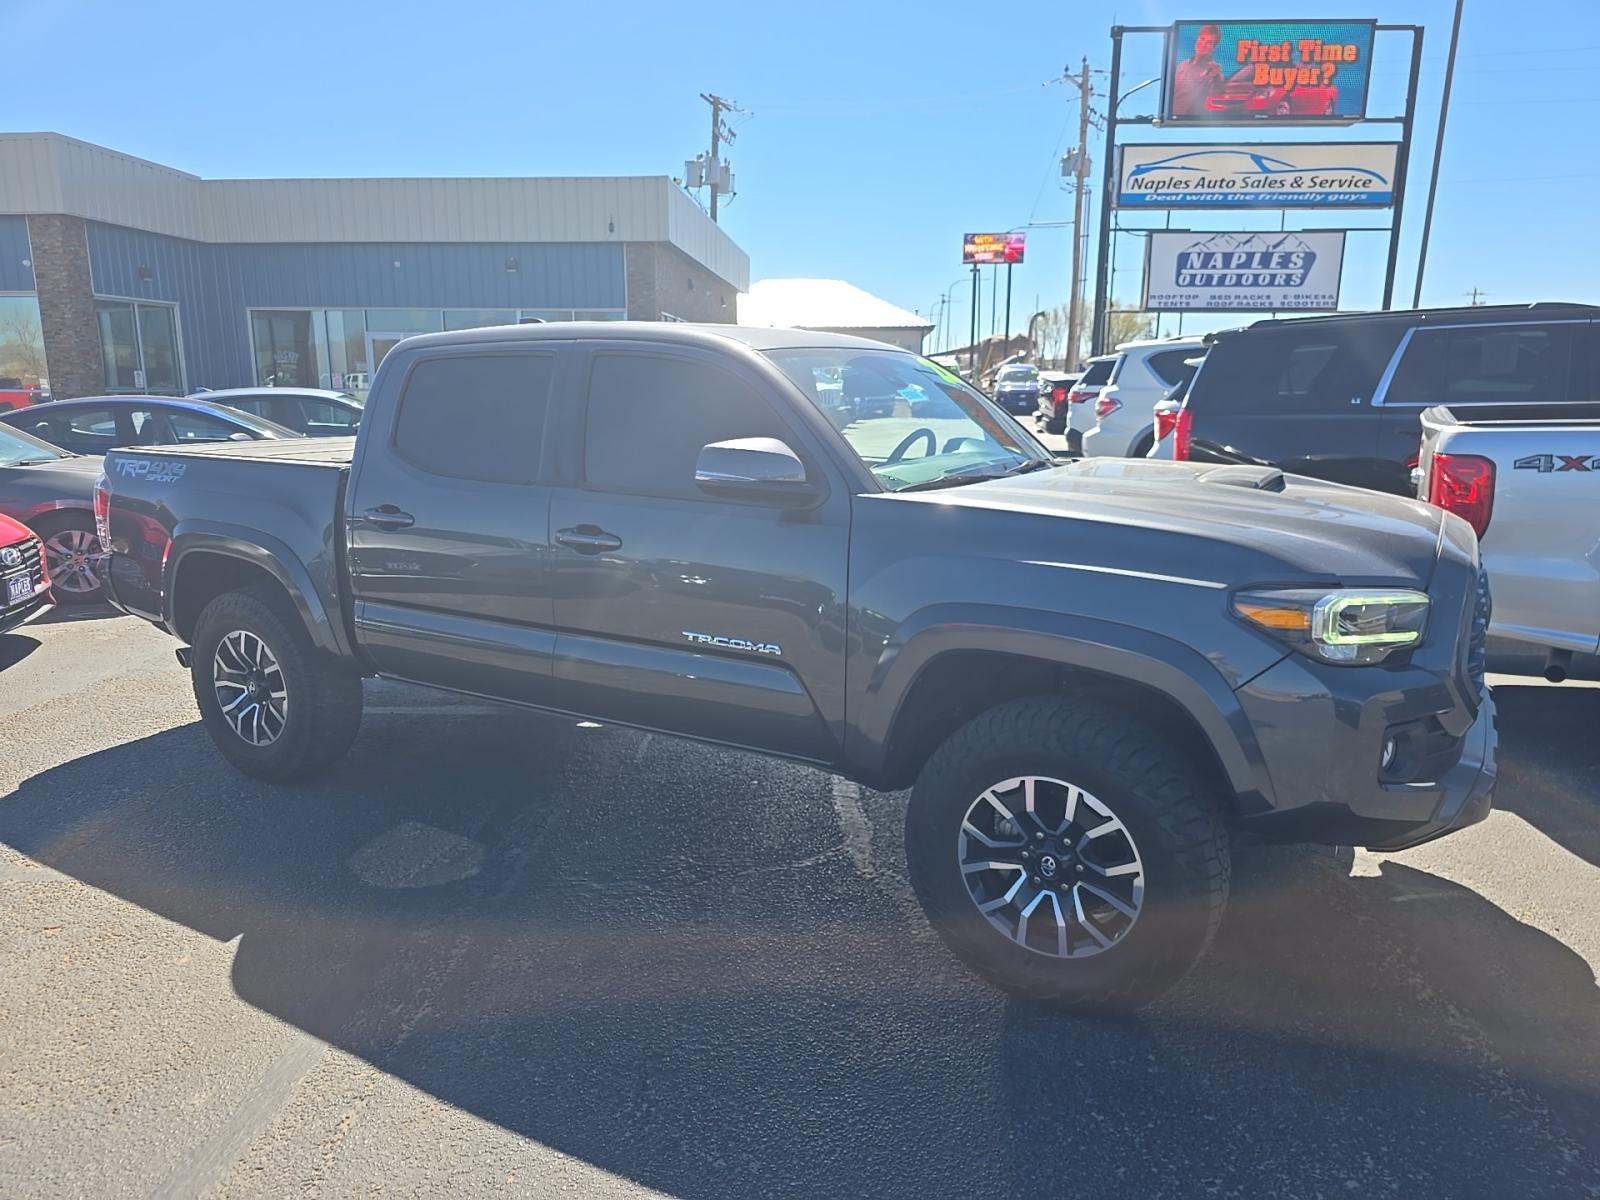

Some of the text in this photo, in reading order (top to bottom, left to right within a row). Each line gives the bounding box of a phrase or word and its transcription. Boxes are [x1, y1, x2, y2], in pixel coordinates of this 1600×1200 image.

[1236, 39, 1357, 62] First Time
[1252, 62, 1336, 91] Buyer?
[1131, 175, 1372, 192] Naples Auto Sales & Service
[1145, 193, 1368, 202] Deal with the friendly guys
[1186, 252, 1305, 269] NAPLES
[1178, 273, 1302, 286] OUTDOORS
[115, 459, 151, 477] TRD
[1513, 454, 1600, 472] 4X
[682, 631, 782, 655] TACOMA
